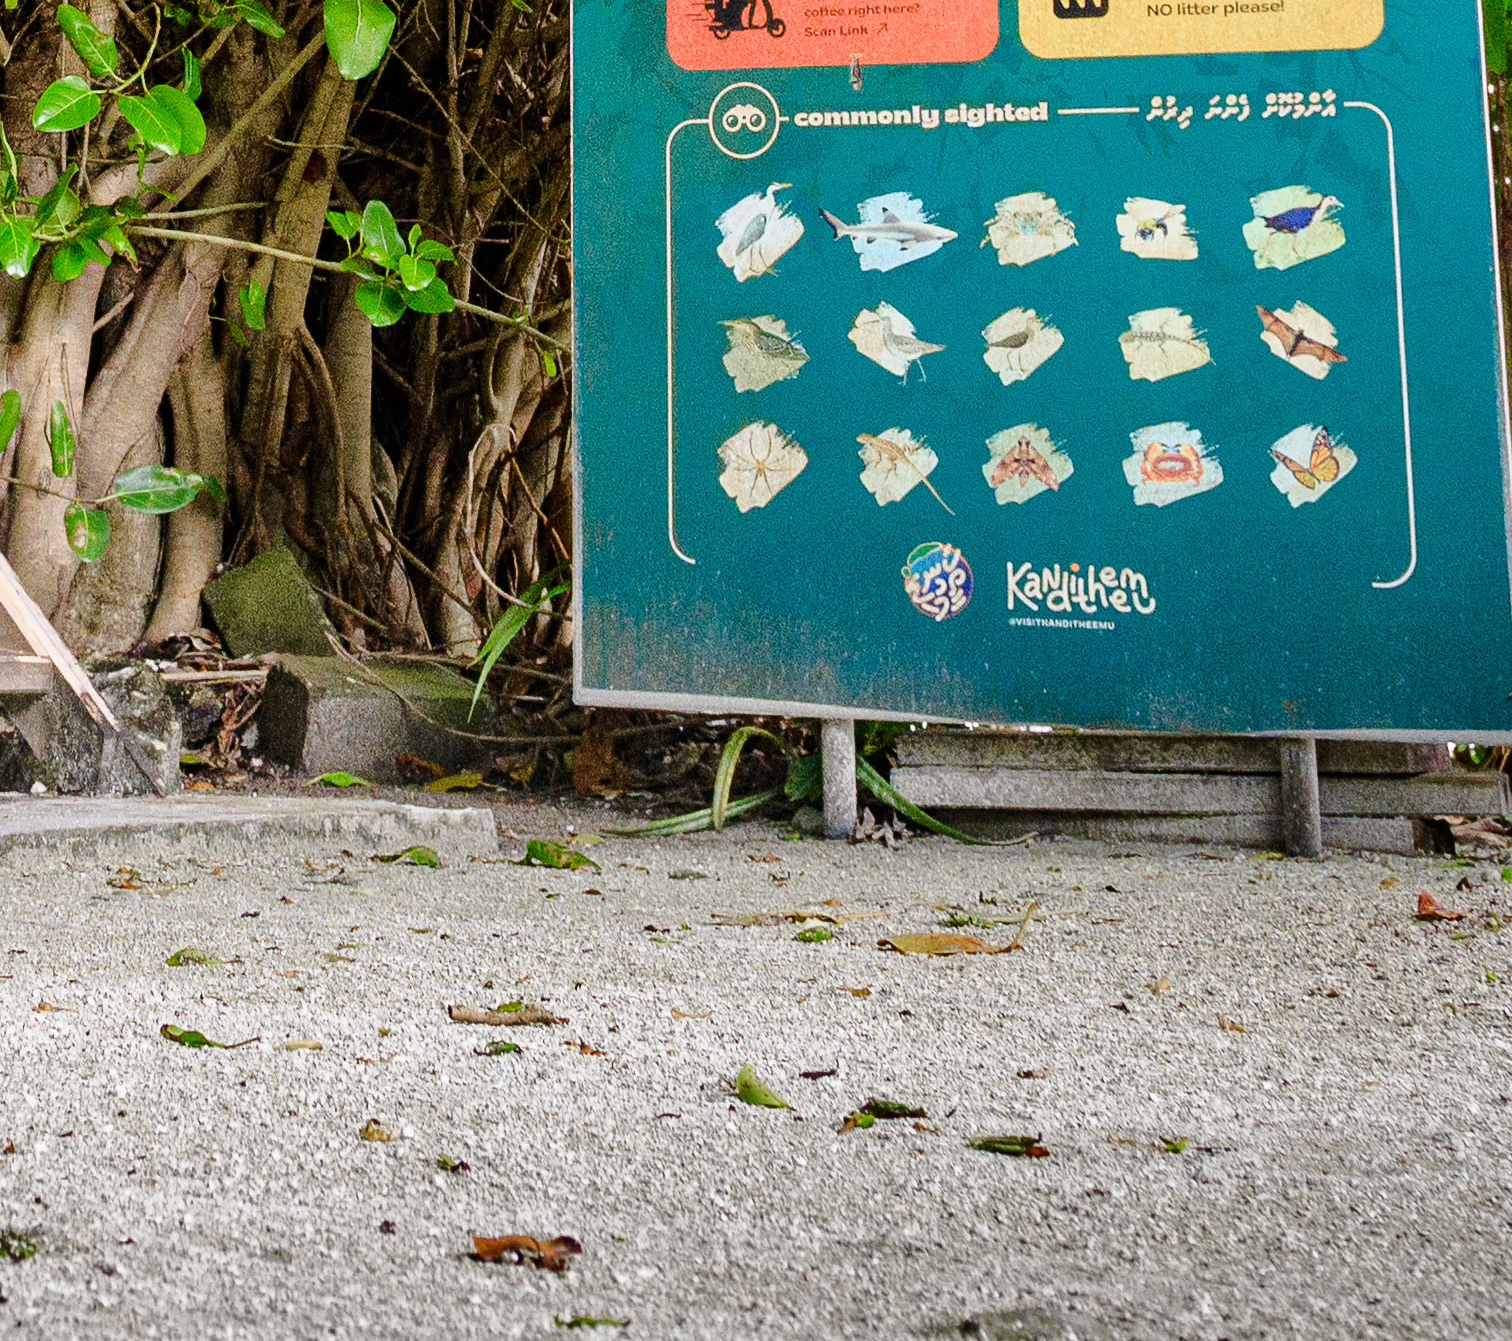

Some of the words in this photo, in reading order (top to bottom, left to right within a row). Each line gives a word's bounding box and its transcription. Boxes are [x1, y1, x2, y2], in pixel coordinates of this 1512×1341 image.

[804, 6, 845, 17] coffee
[847, 4, 880, 18] right
[1147, 3, 1173, 17] NO
[1177, 1, 1219, 16] litter
[1223, 0, 1285, 17] please!
[804, 26, 836, 38] Scan
[839, 24, 869, 37] Link
[793, 104, 940, 129] commonly
[944, 101, 1049, 128] sighted
[1204, 93, 1250, 122] ފެންނަ
[1009, 617, 1116, 631] @VISITKANDITHEEMU
